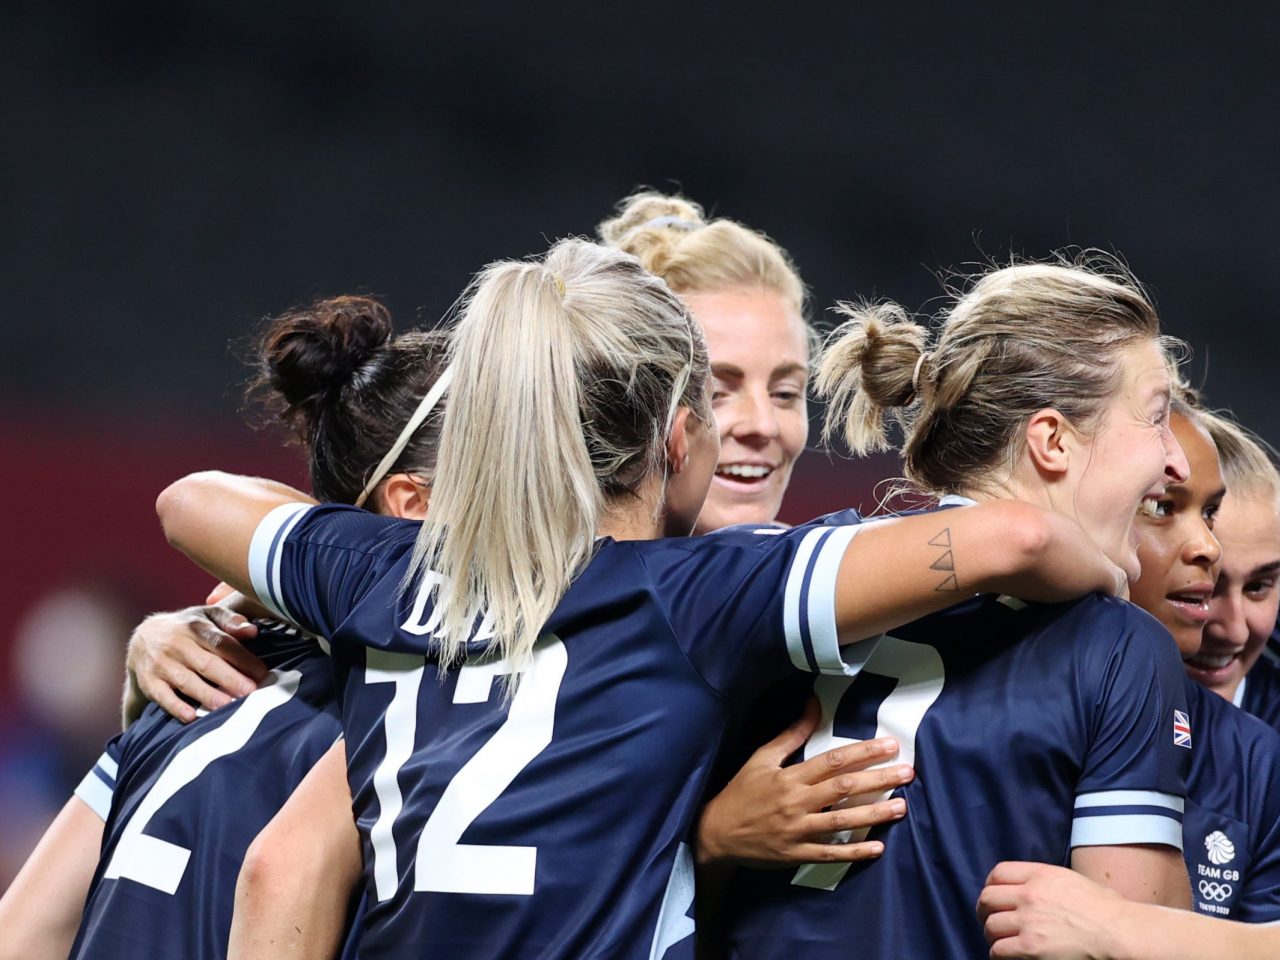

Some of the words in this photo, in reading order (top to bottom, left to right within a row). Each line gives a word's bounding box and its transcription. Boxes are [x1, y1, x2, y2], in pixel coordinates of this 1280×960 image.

[364, 632, 568, 902] 12
[1198, 864, 1221, 879] TEAM
[1223, 869, 1240, 881] GB
[1199, 902, 1216, 913] TOKYO
